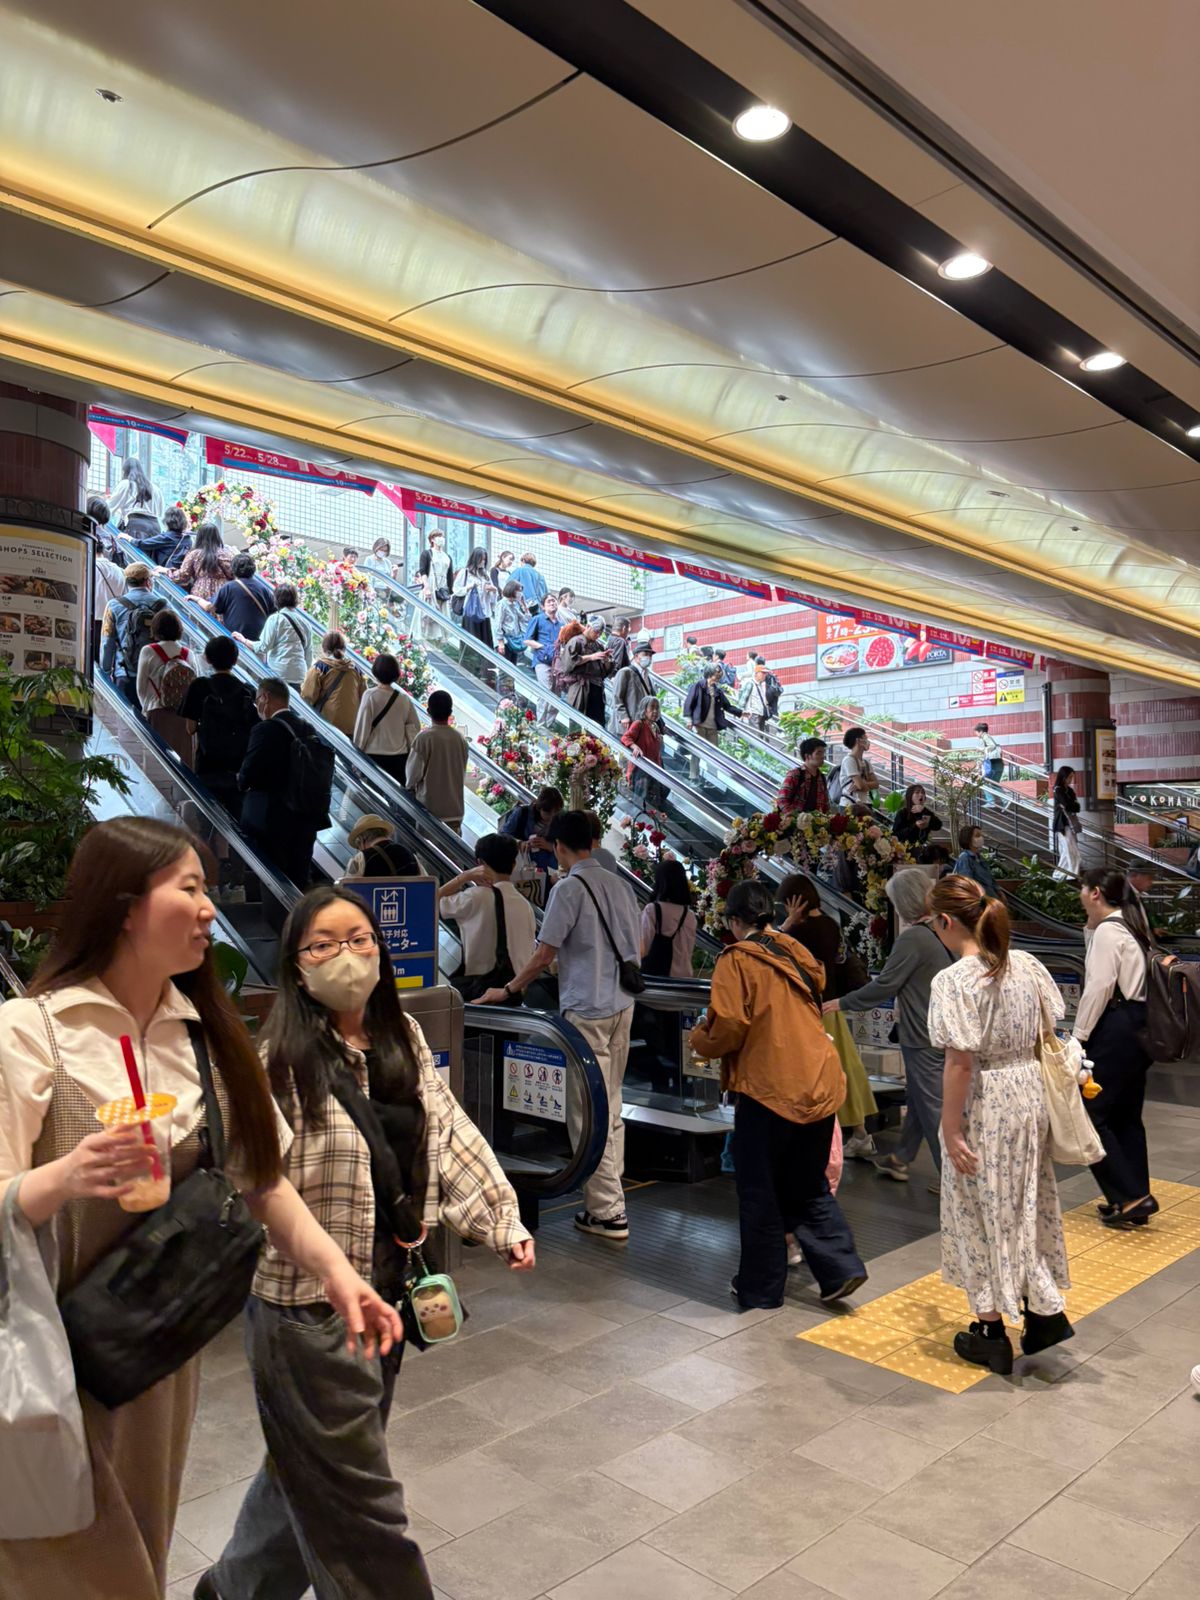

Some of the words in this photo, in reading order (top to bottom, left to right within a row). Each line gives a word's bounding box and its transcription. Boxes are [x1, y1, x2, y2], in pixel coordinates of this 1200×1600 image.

[224, 444, 246, 457] 5/22
[257, 453, 279, 466] 5/28
[32, 550, 73, 563] SELECTION
